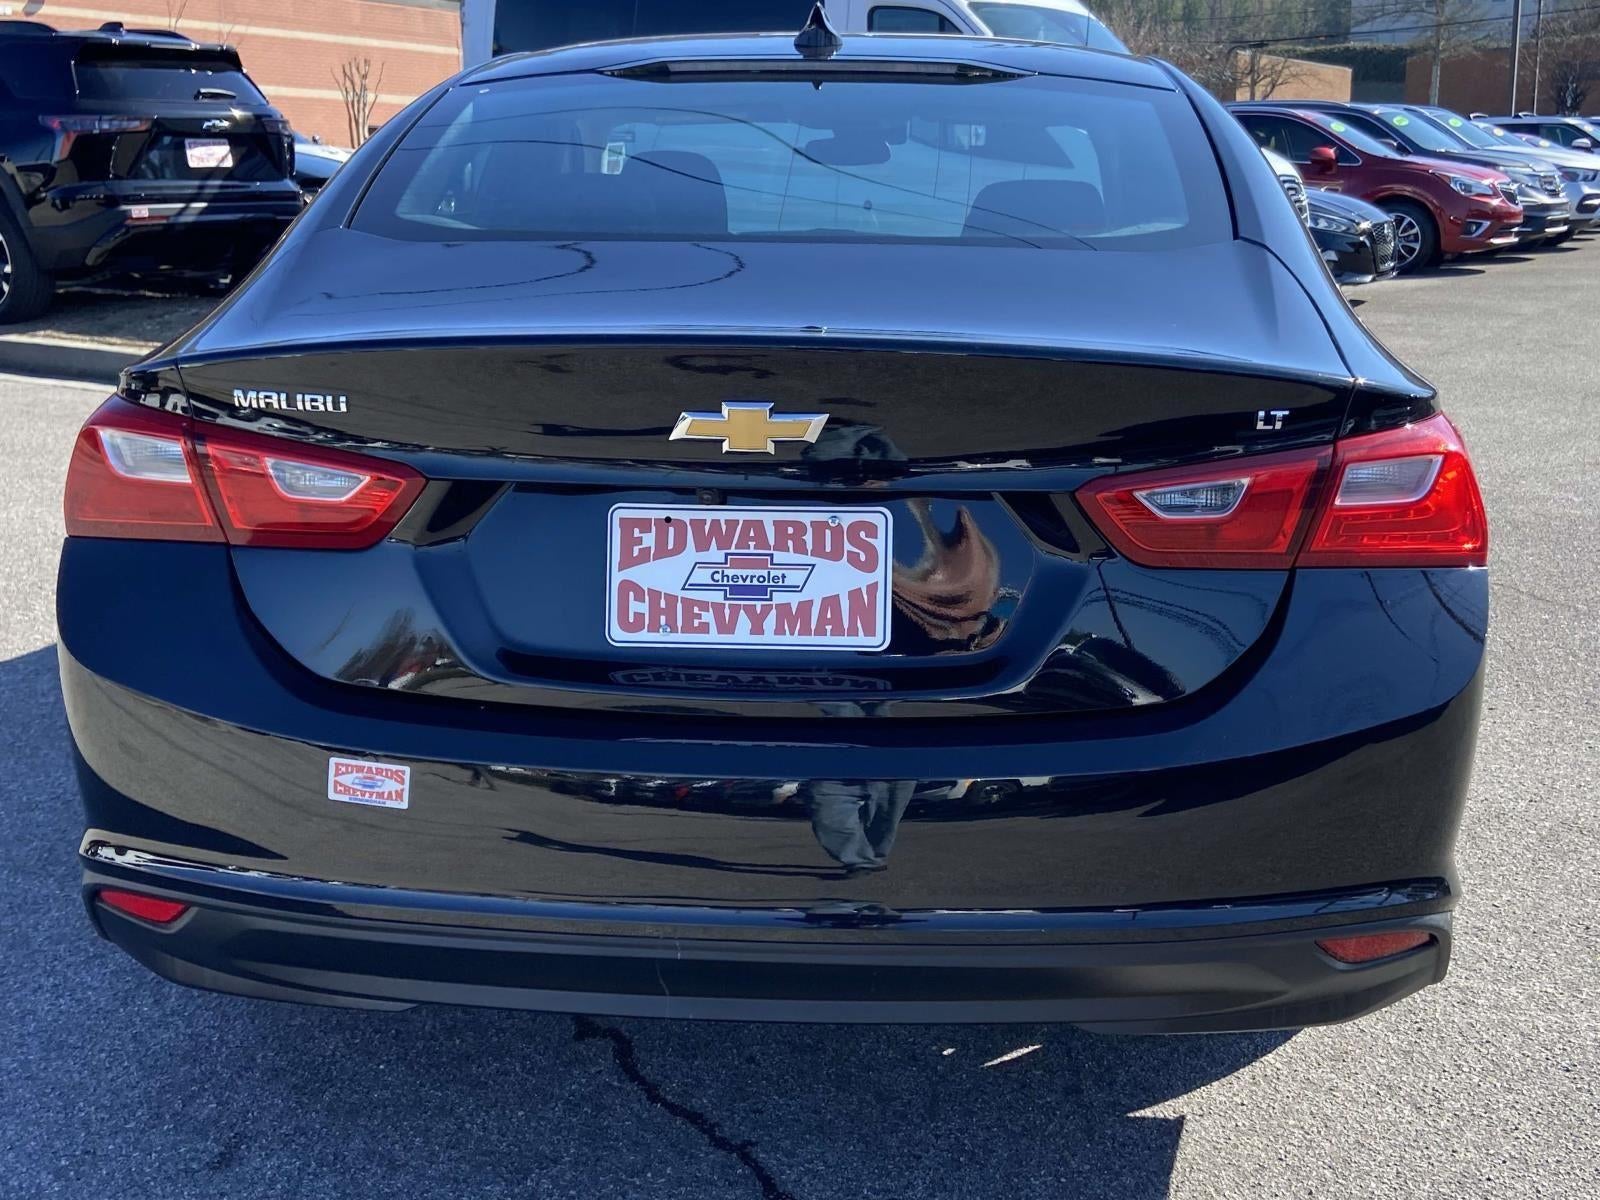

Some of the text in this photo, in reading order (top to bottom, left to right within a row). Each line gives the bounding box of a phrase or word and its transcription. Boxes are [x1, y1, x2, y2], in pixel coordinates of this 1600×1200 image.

[233, 389, 347, 412] MALIBU
[1256, 410, 1290, 430] LT
[618, 517, 879, 574] EDWARDS
[710, 570, 787, 585] Chevrolet
[617, 579, 879, 638] CHEVYMAN
[334, 762, 406, 786] EDWARDS
[334, 780, 405, 802] CHEVYMAN
